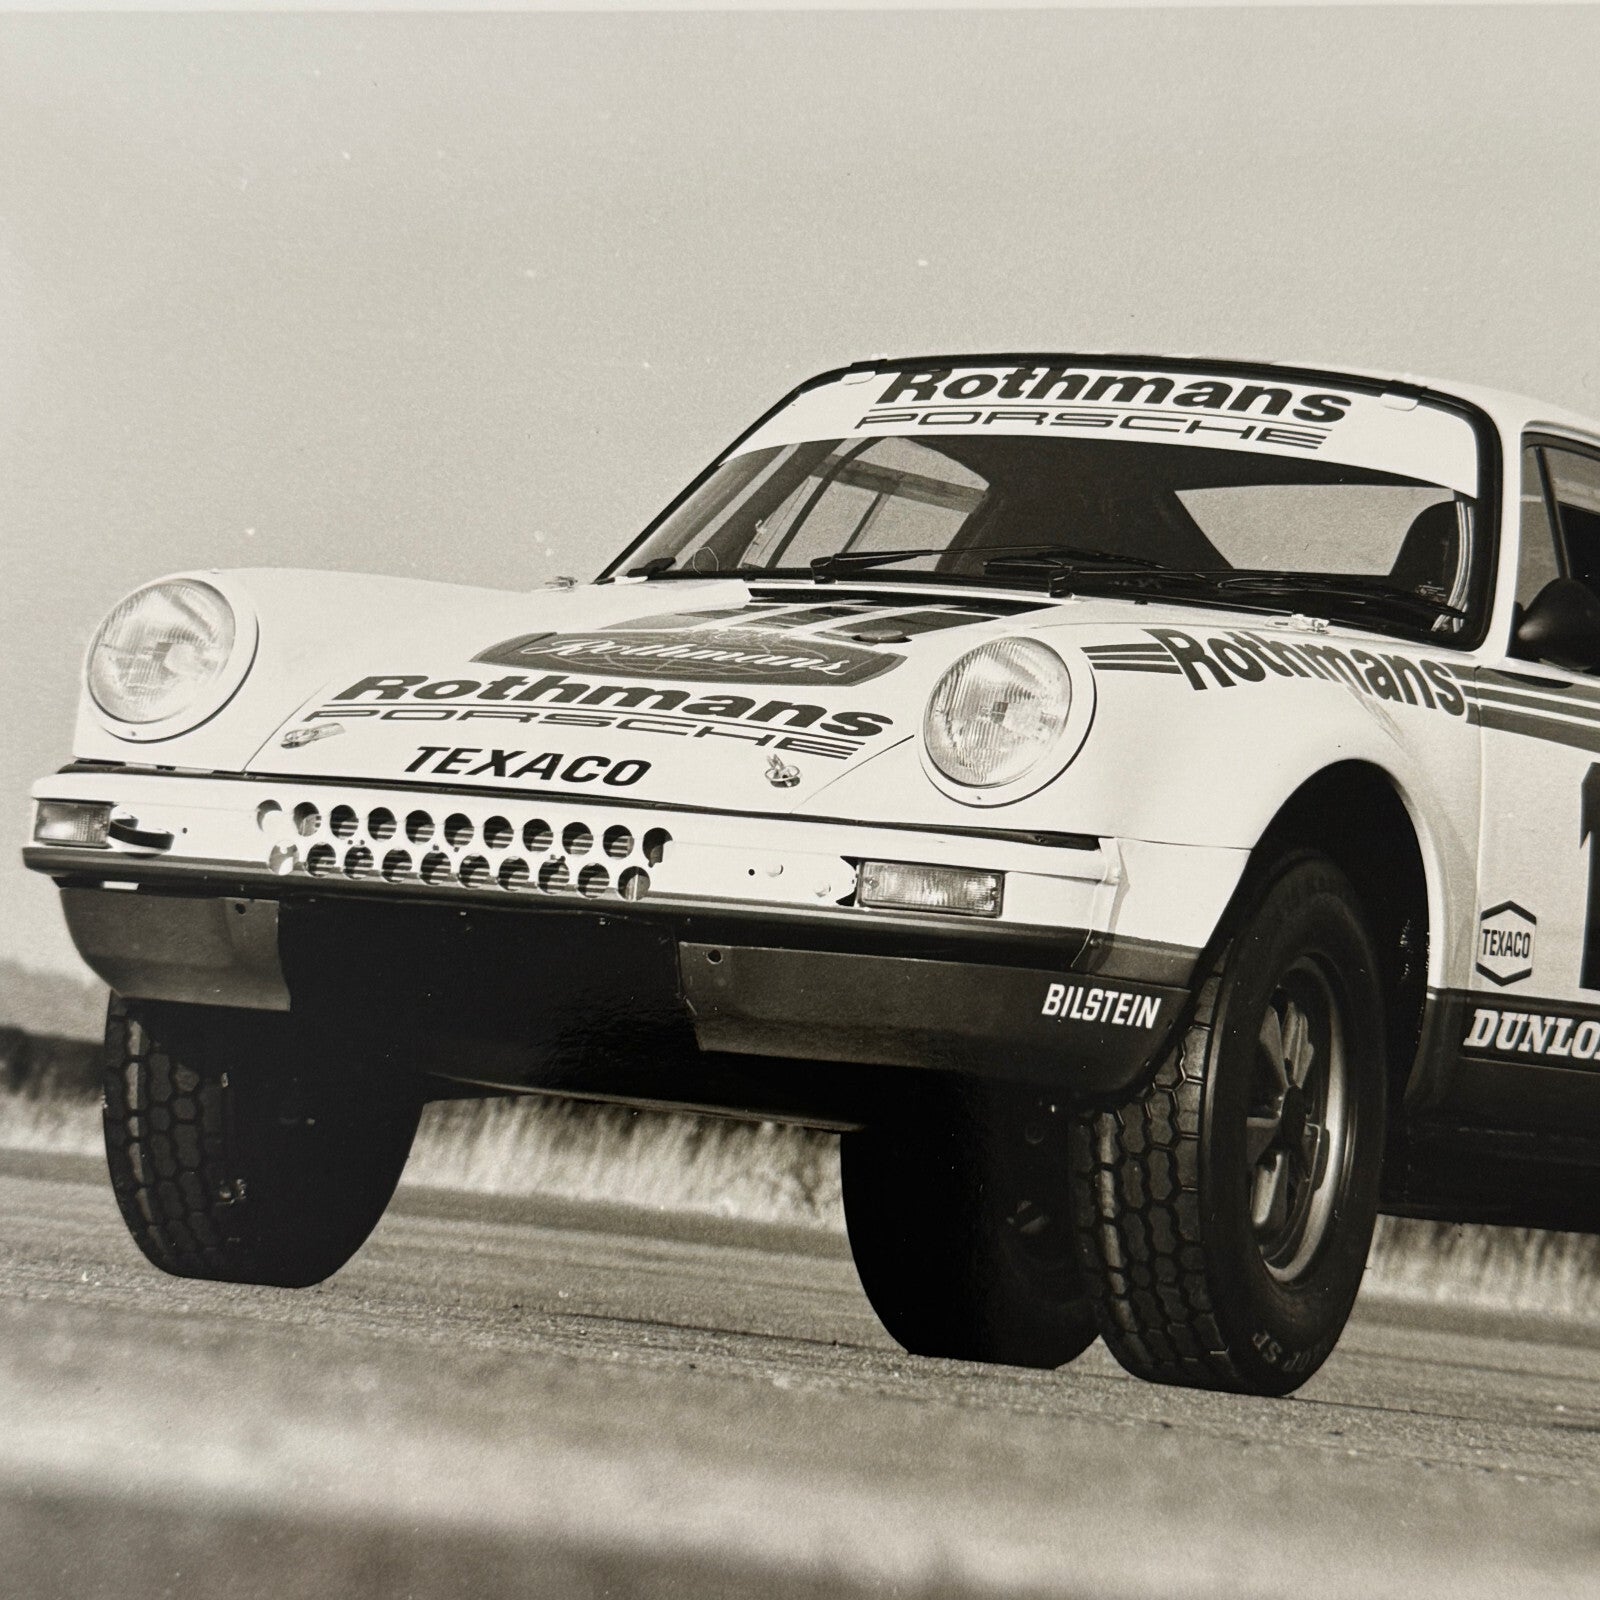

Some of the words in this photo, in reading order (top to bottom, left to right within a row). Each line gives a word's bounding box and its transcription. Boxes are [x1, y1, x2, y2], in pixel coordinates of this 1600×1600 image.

[875, 368, 1351, 423] Rothmans
[854, 411, 1329, 450] PORSCHE
[520, 638, 851, 675] Rothmans
[1141, 628, 1465, 716] Rothmans
[332, 674, 894, 738] Rothmans
[301, 708, 862, 760] PORSCHE
[403, 746, 652, 787] TEXACO
[1481, 928, 1531, 959] TEXACO
[1041, 982, 1161, 1029] BILSTEIN
[1463, 1008, 1600, 1060] DUNLO
